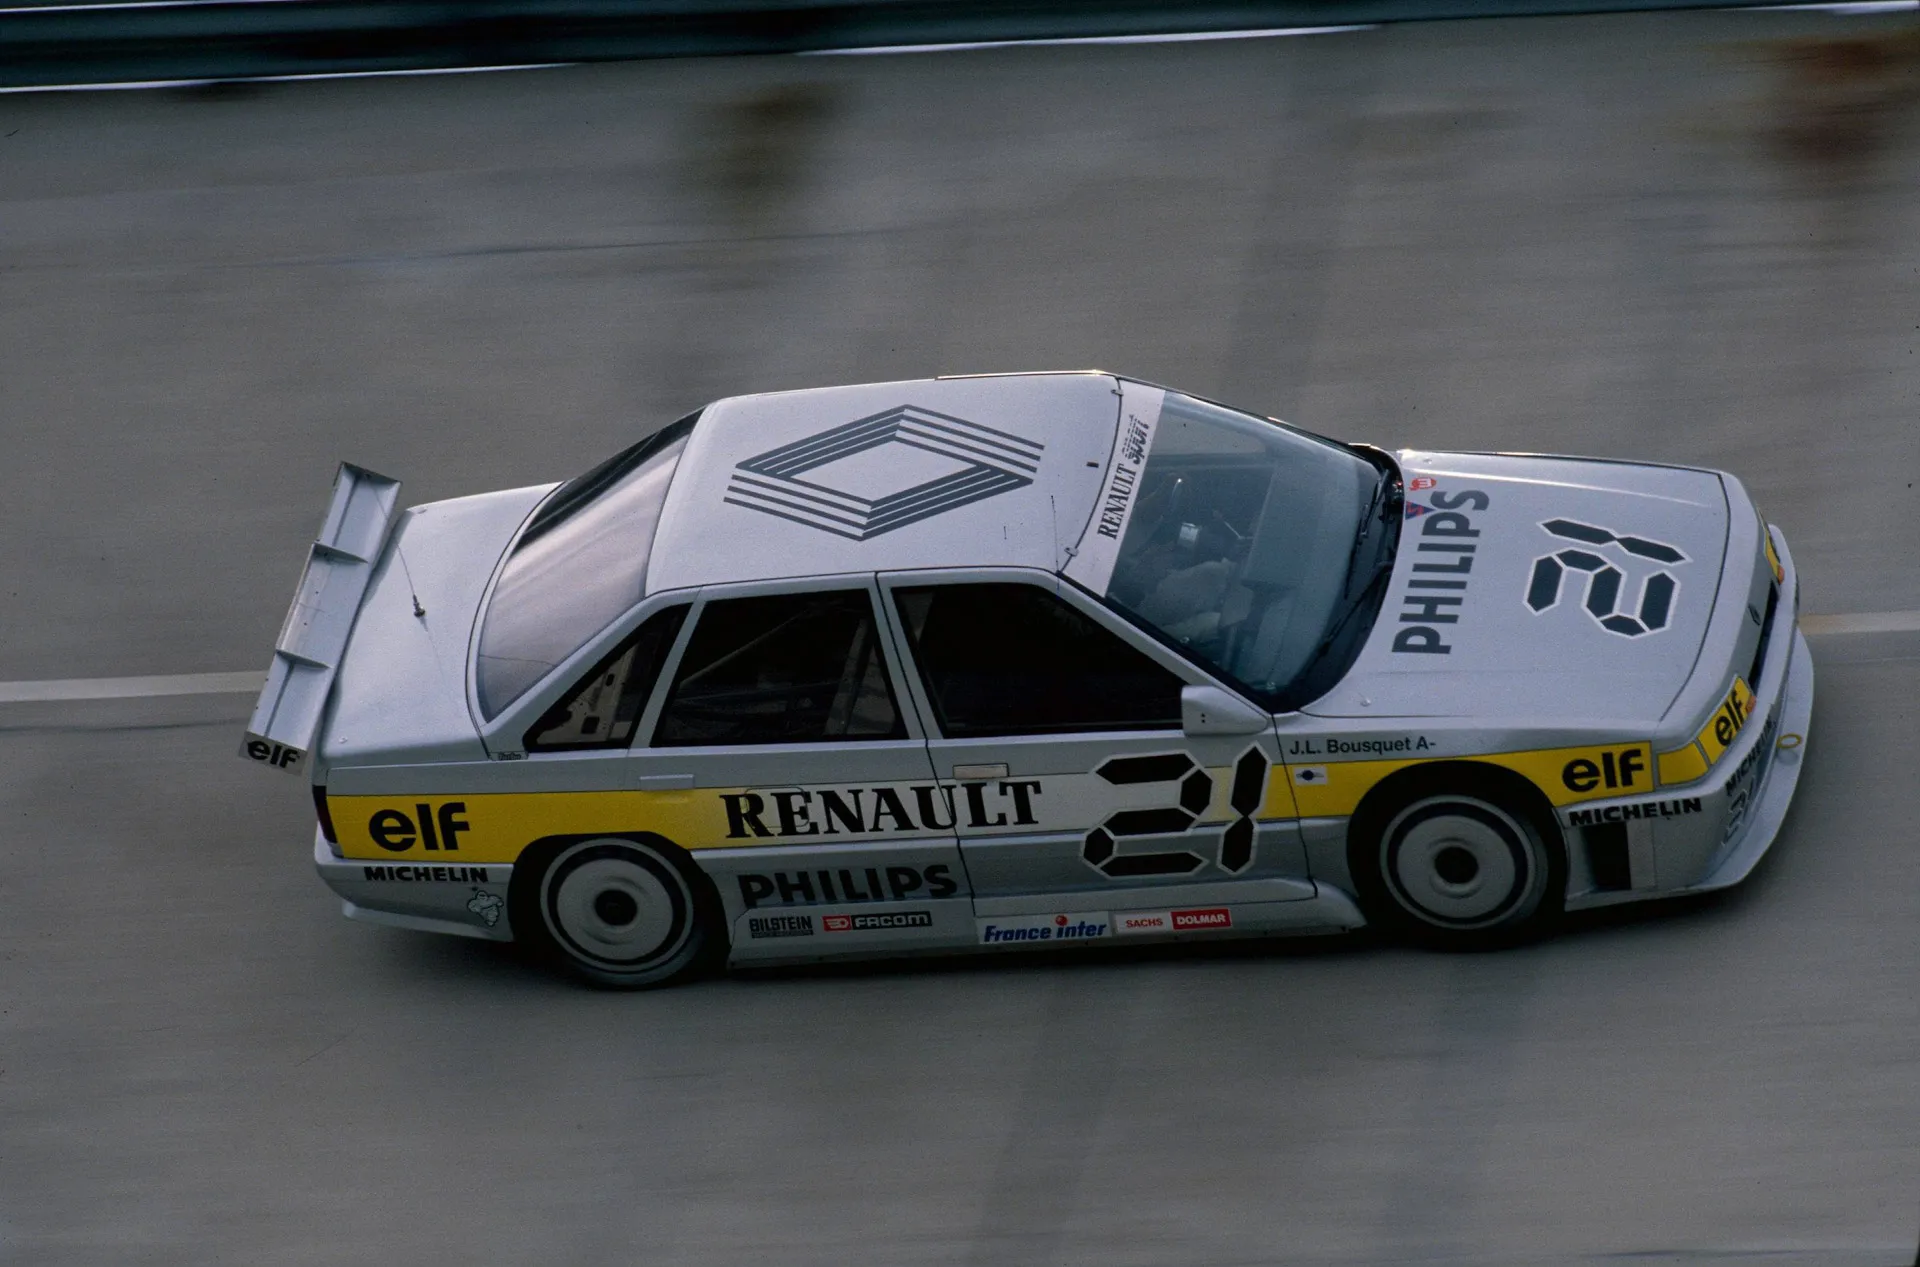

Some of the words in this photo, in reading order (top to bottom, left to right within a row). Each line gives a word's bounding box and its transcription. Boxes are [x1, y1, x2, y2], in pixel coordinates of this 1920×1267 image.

[1097, 463, 1139, 540] RENAULT
[1391, 489, 1489, 655] PHILIPS
[1523, 517, 1694, 638] 21
[1714, 687, 1746, 748] elf
[246, 739, 301, 769] elf
[1289, 740, 1322, 755] J.L.
[1327, 737, 1411, 755] Bousquet
[1562, 749, 1645, 793] elf
[368, 801, 471, 852] elf
[719, 780, 1042, 839] RENAULT
[1082, 743, 1271, 880] 21
[1569, 797, 1701, 827] MICHELIN
[364, 865, 489, 883] MICHELIN
[737, 865, 957, 908] PHILIPS
[748, 915, 813, 933] BILSTEIN
[853, 912, 929, 928] FACOM
[984, 923, 1051, 943] France
[1056, 915, 1107, 940] inter
[1125, 917, 1164, 928] SACHS
[1176, 913, 1227, 926] DOLMAR
